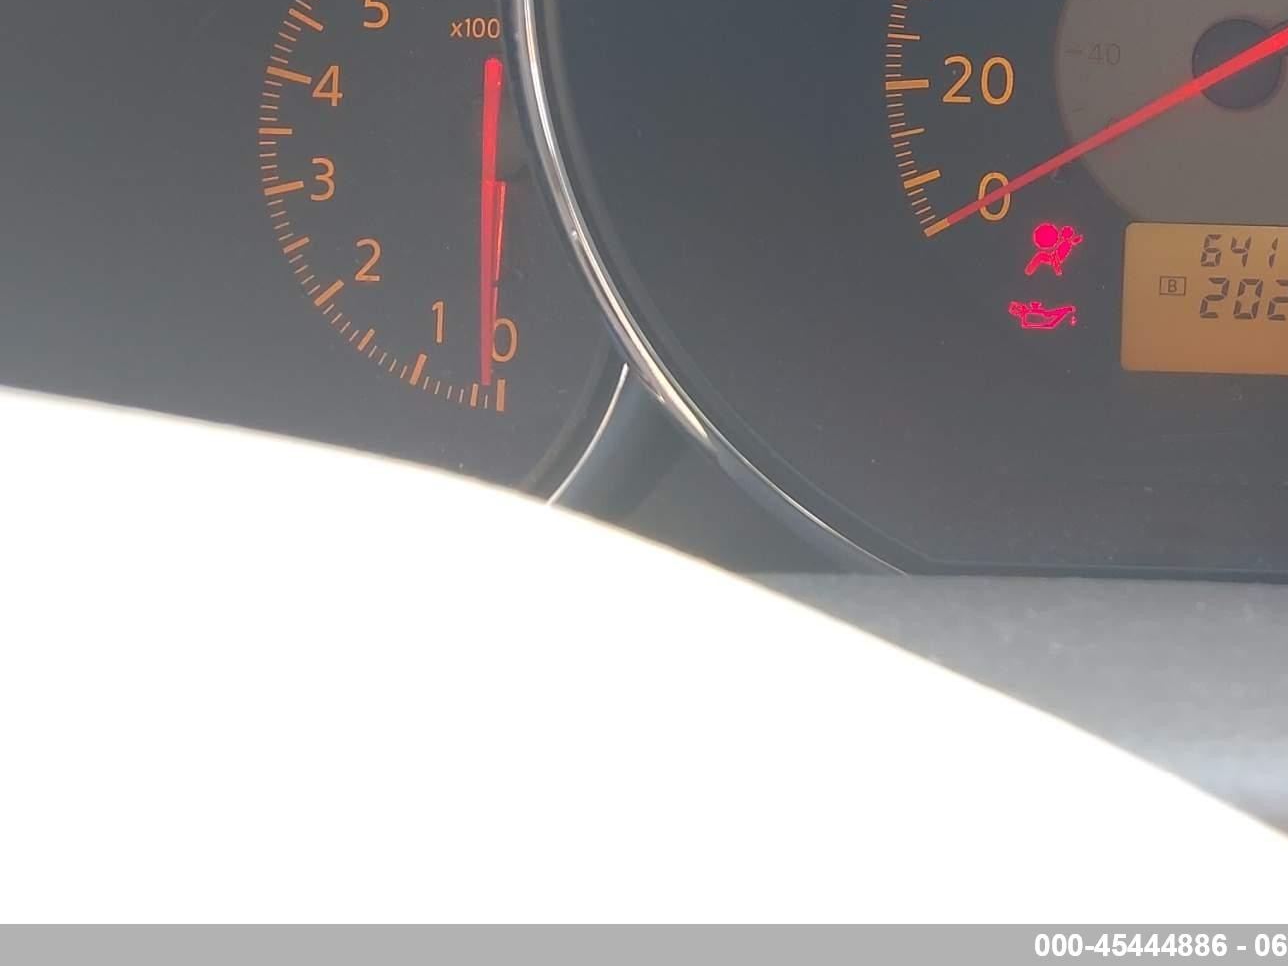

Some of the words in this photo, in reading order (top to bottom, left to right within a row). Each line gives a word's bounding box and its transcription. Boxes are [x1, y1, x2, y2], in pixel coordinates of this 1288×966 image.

[1088, 43, 1121, 66] 40
[312, 65, 342, 107] 4
[942, 55, 1015, 106] 20
[310, 157, 336, 202] 3
[977, 171, 1012, 222] 0
[355, 238, 380, 282] 2
[431, 300, 446, 343] 1
[490, 317, 519, 362] 0
